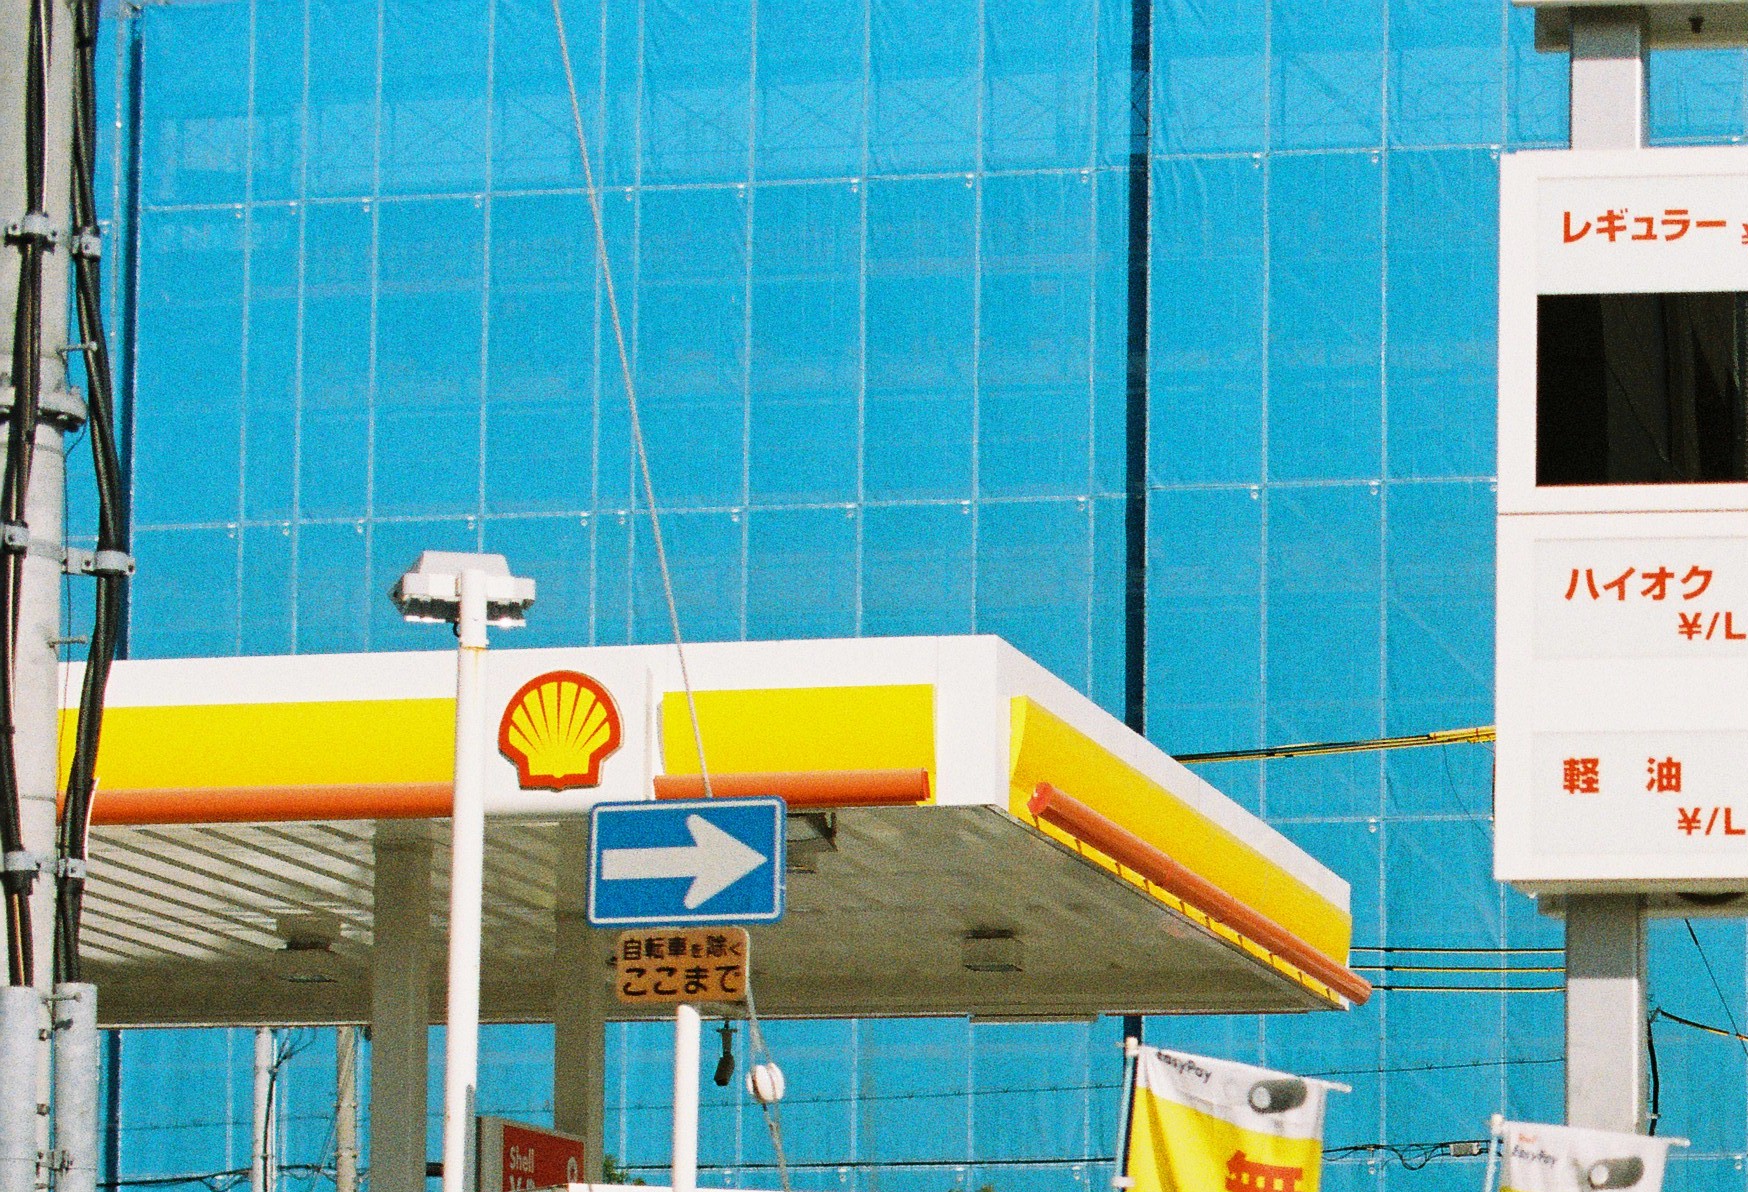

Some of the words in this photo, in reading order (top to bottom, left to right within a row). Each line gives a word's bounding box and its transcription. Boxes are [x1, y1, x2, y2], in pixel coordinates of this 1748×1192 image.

[1563, 208, 1727, 244] レギュラー
[1565, 565, 1713, 602] ハイオク
[1677, 611, 1747, 641] ¥/L
[1677, 806, 1747, 837] ¥/L
[622, 964, 741, 996] ここまで
[509, 1145, 535, 1173] Shell
